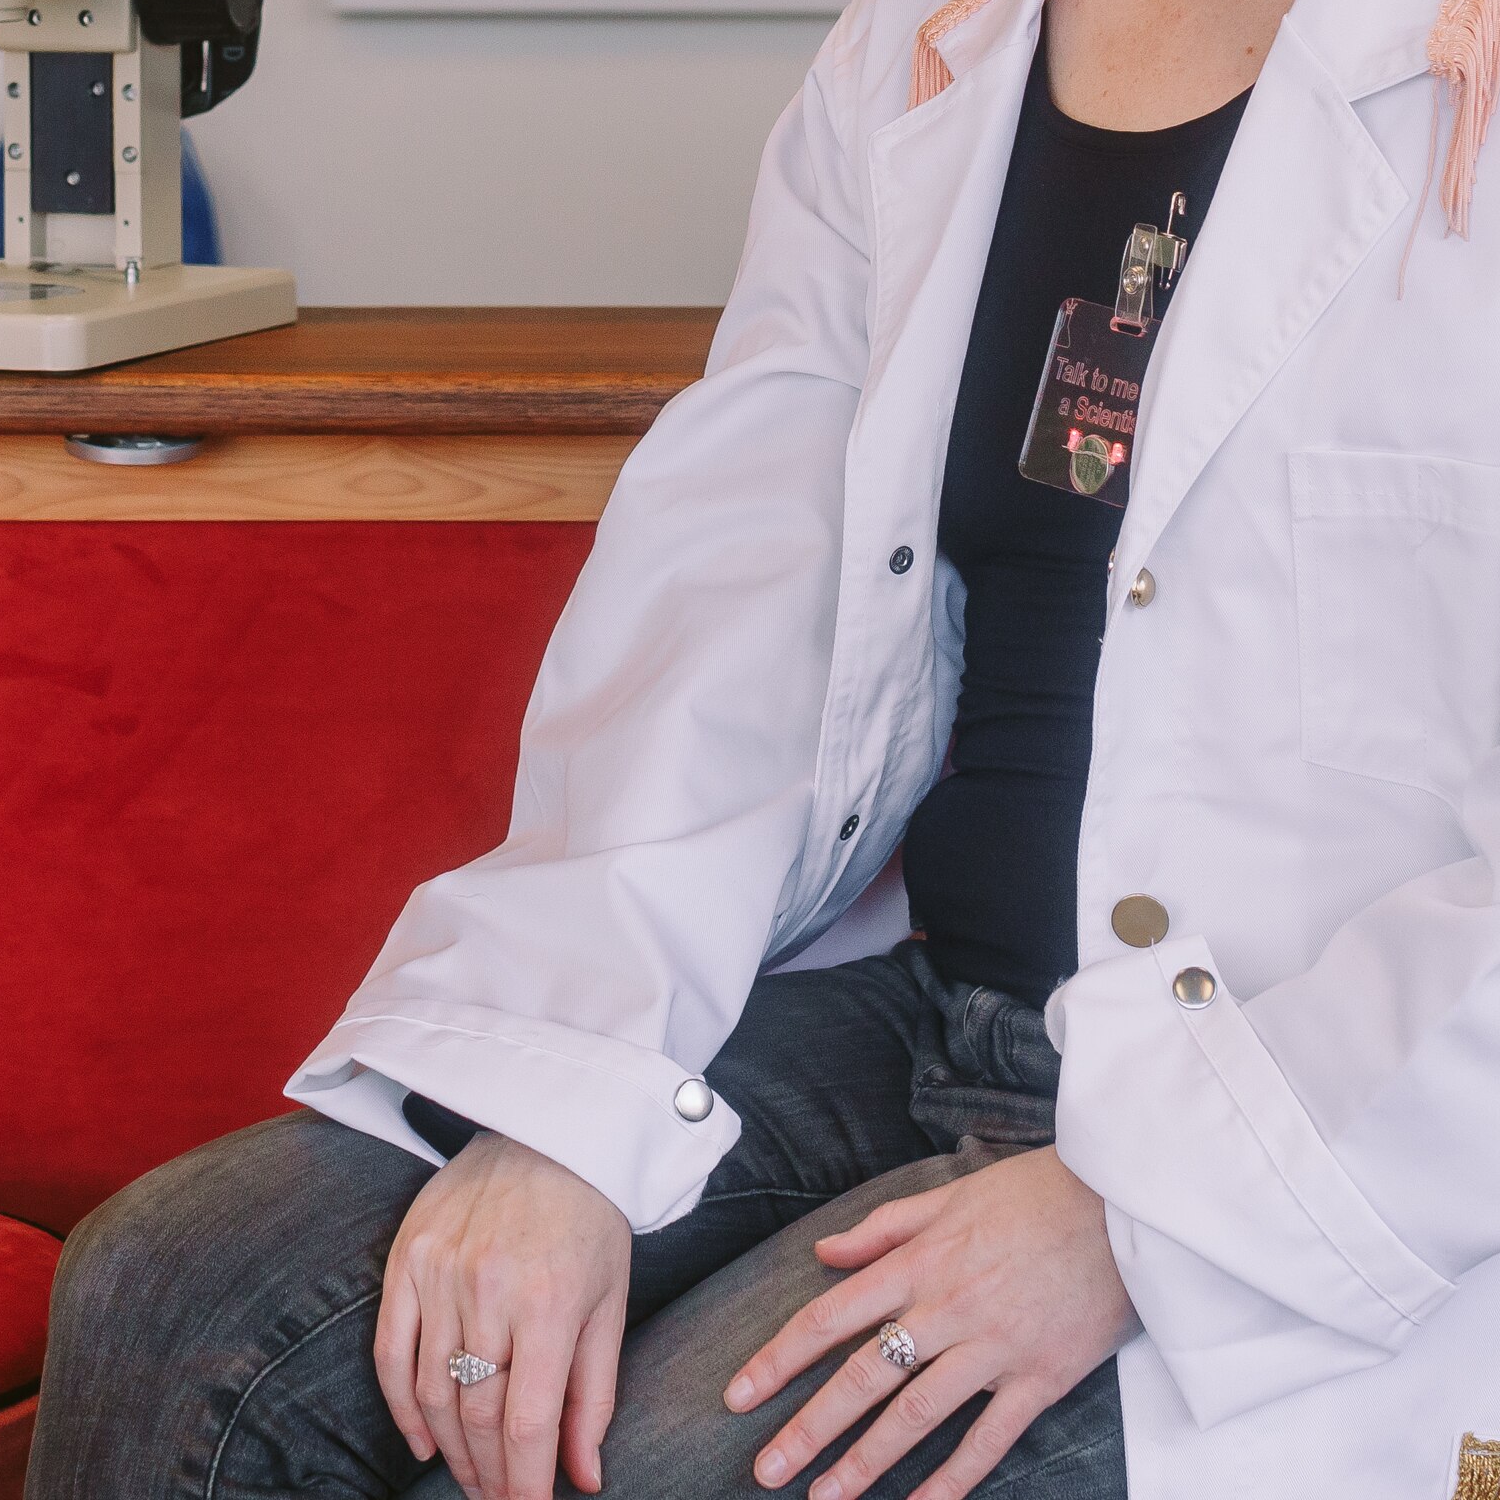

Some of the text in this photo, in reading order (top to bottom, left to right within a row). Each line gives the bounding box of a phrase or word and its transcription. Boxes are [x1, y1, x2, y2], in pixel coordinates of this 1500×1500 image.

[1056, 356, 1139, 401] Talk to me
[1058, 396, 1136, 435] a Scientis
